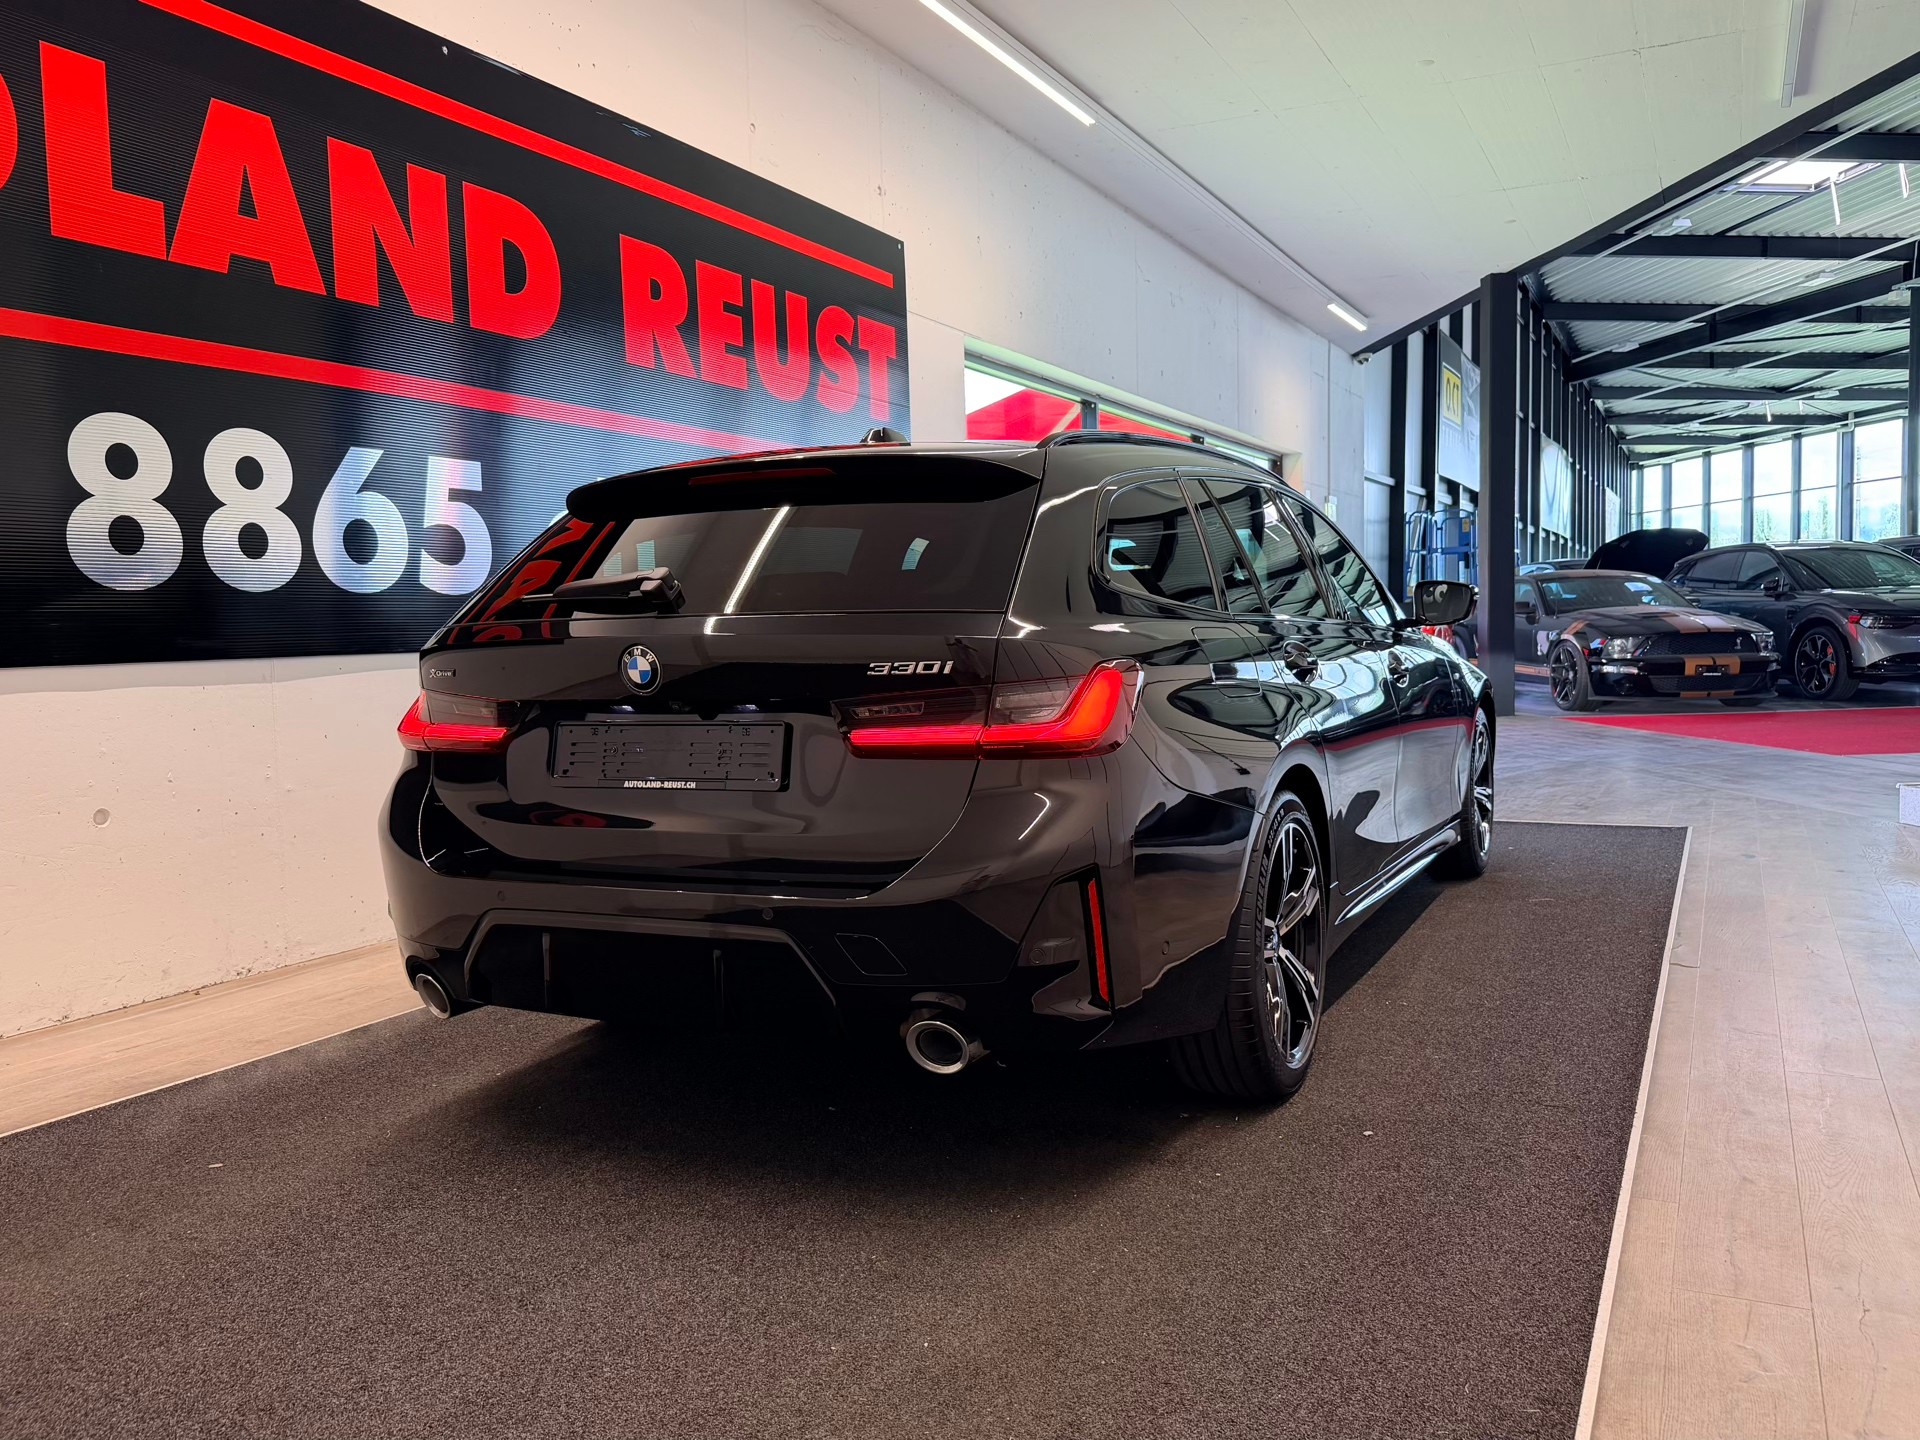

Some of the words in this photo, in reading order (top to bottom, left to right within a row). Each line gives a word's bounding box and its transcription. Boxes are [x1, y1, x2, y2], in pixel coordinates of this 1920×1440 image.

[0, 40, 562, 340] LAND
[619, 233, 897, 422] REUST
[66, 411, 493, 595] 8865
[624, 648, 655, 663] BMW
[867, 660, 954, 676] 330i
[623, 780, 696, 789] AUTOLAND-REUST.CH
[1255, 855, 1268, 945] MICHELIN
